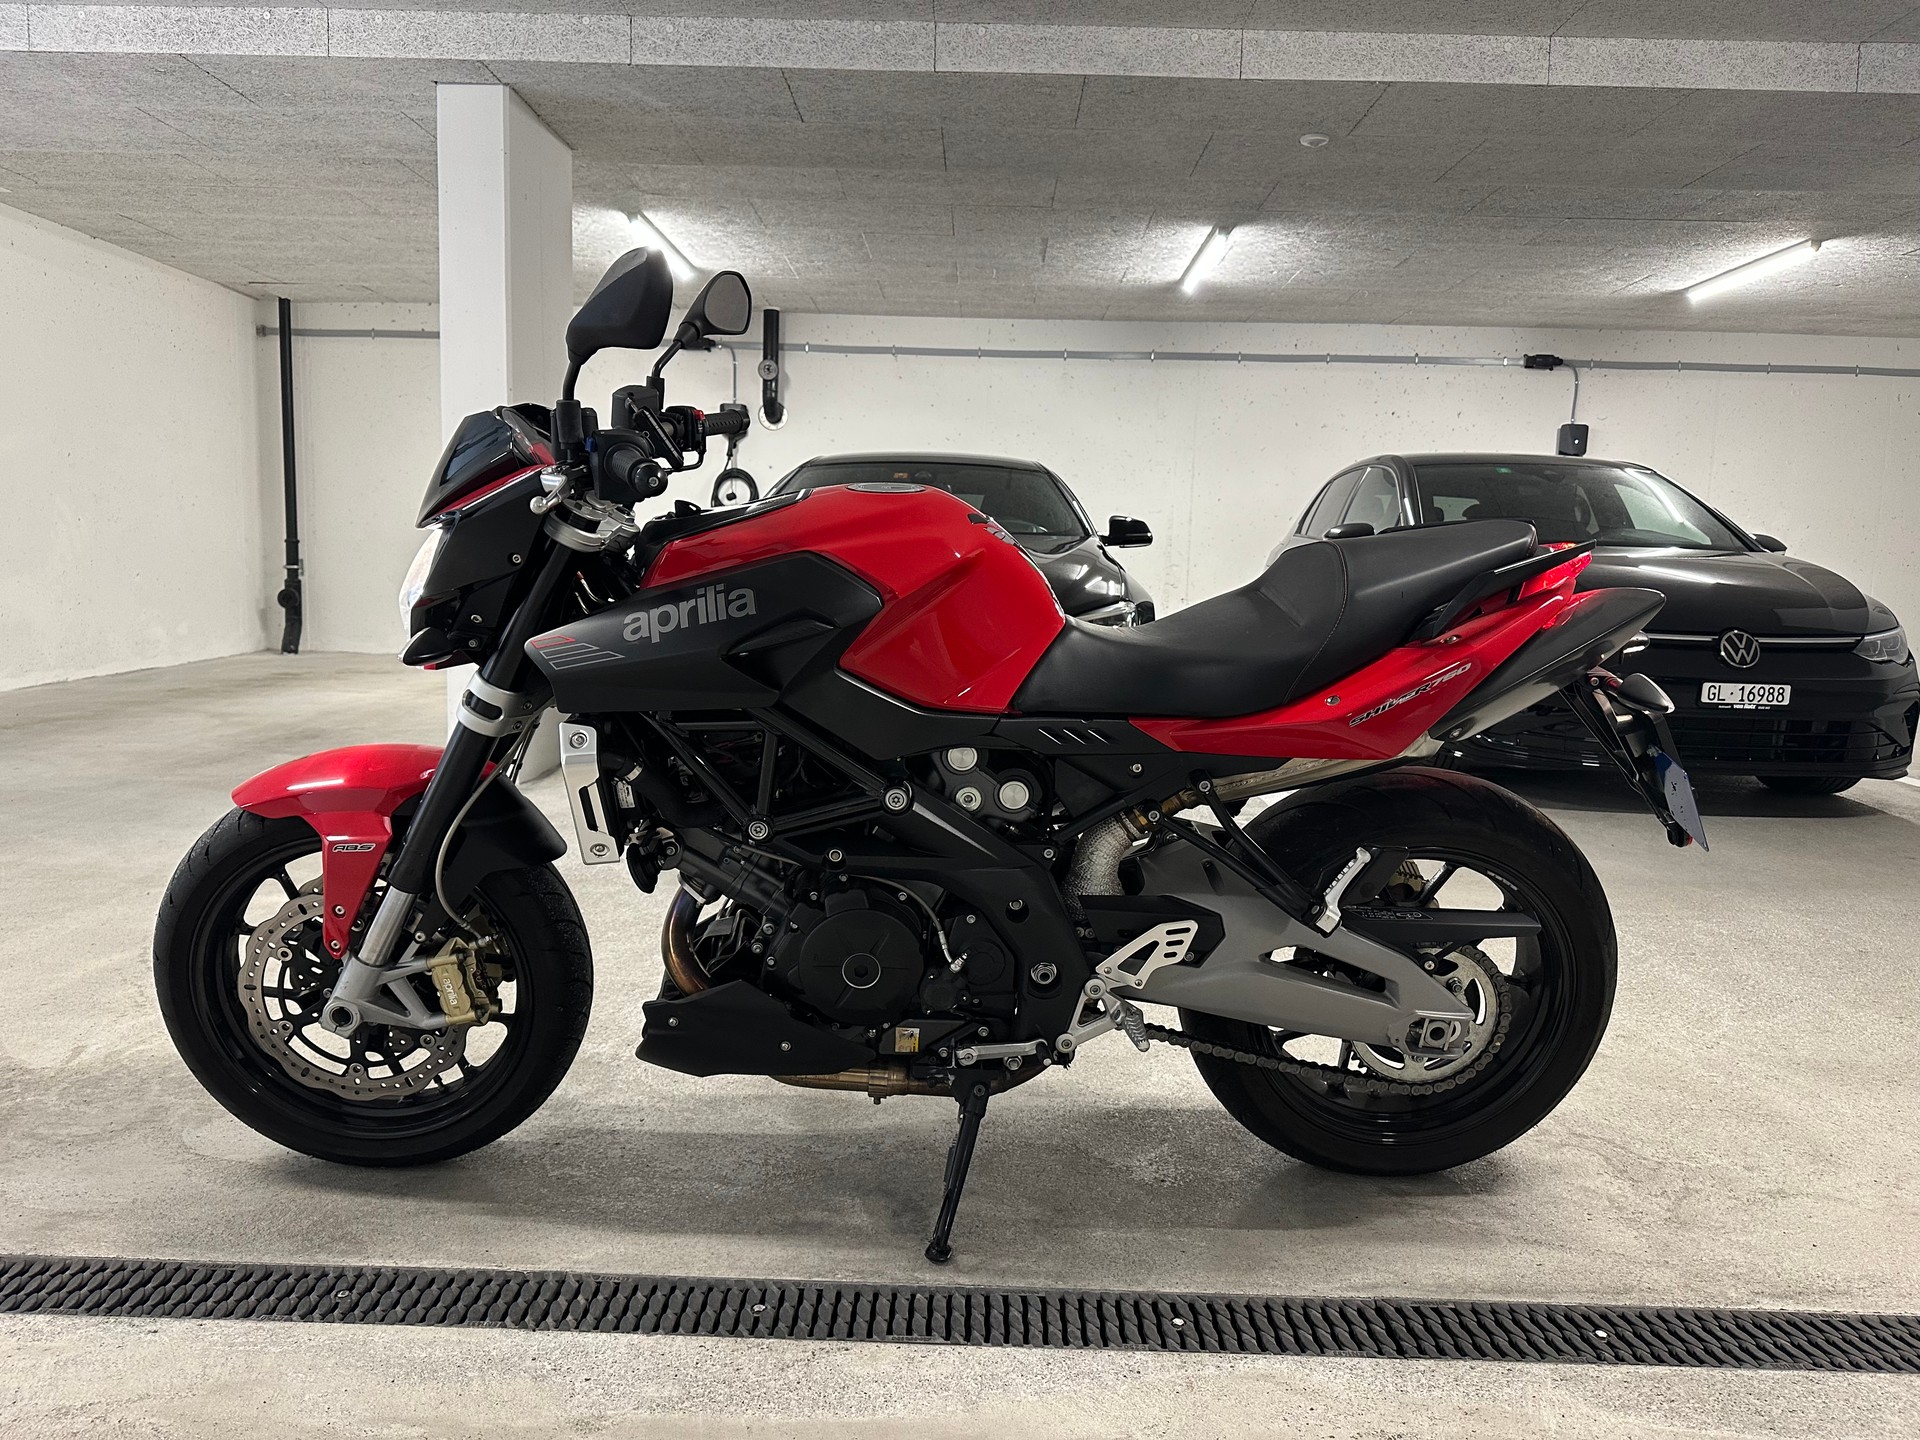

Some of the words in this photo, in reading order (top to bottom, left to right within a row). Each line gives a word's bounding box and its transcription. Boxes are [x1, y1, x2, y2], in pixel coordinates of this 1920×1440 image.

[622, 583, 757, 644] aprilia
[1738, 685, 1786, 703] 16988
[332, 843, 377, 853] ABS
[443, 978, 458, 1006] aprilia
